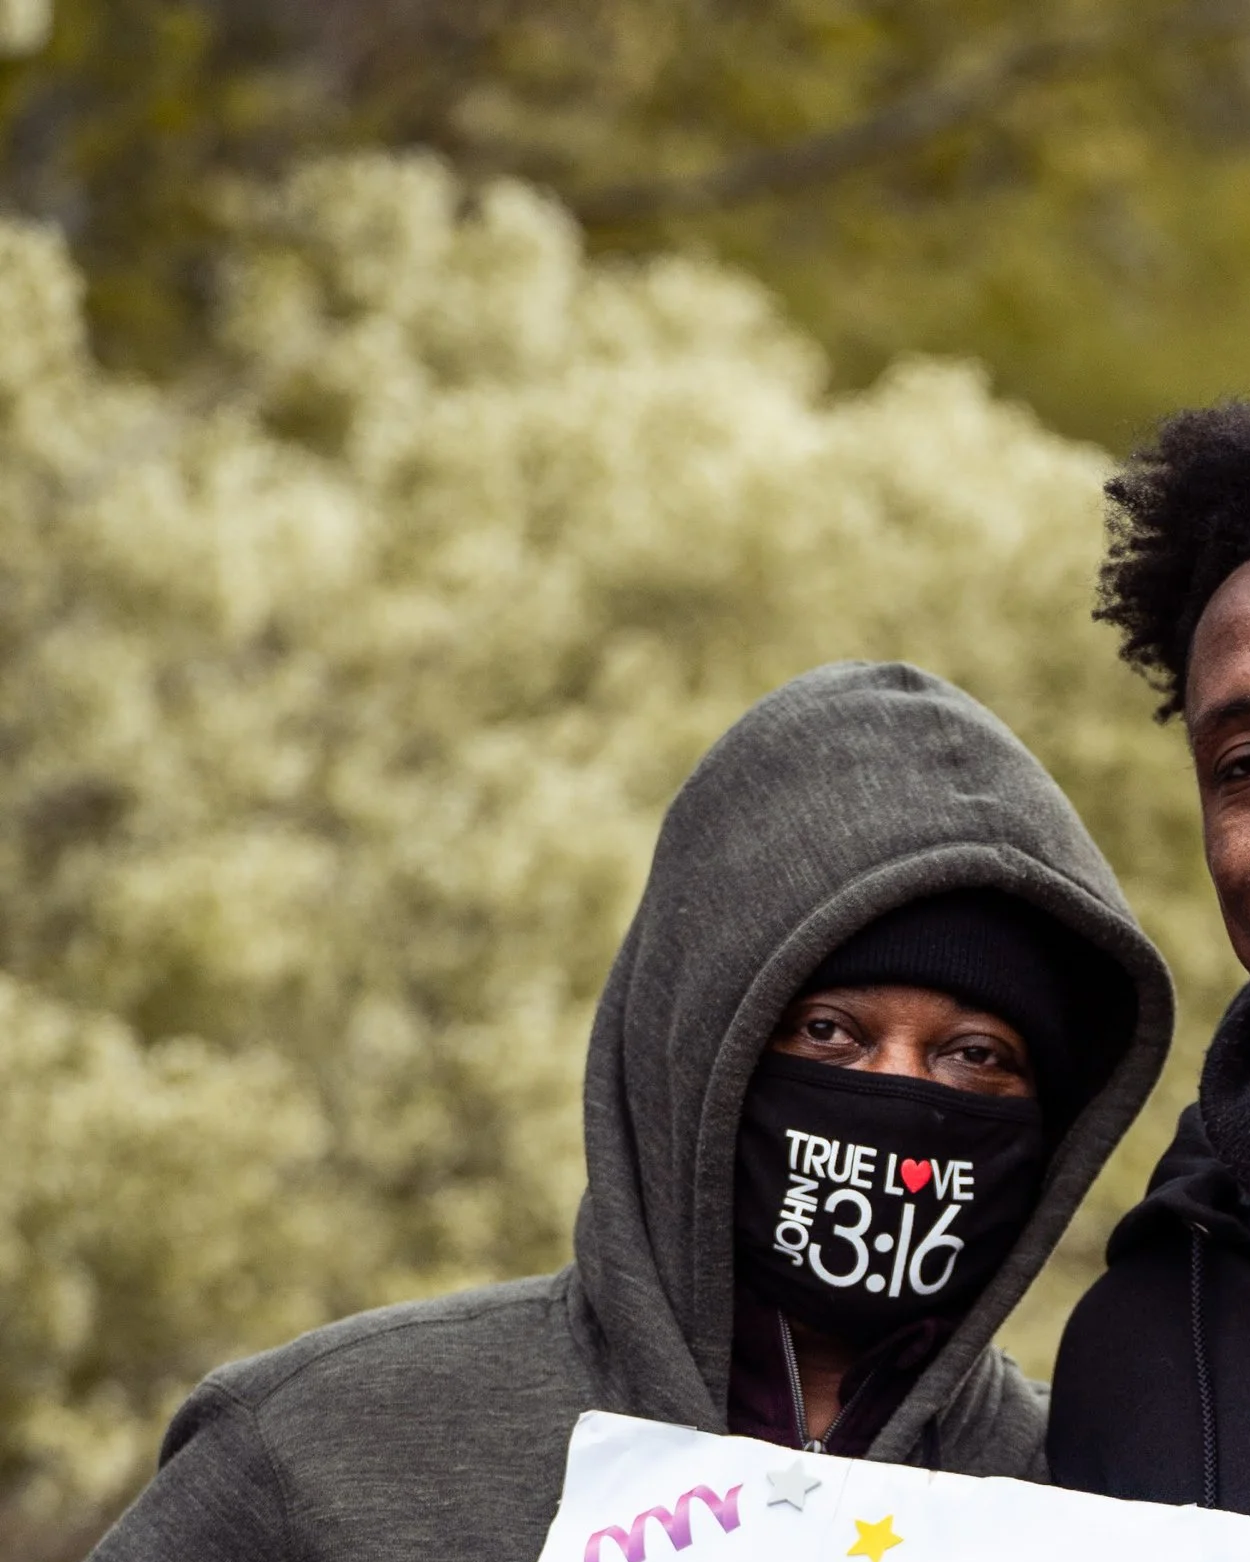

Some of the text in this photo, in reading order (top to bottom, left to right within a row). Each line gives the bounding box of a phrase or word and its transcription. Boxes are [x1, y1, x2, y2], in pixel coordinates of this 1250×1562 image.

[785, 1129, 877, 1189] TRUE
[773, 1173, 965, 1298] JOHN 3:16
